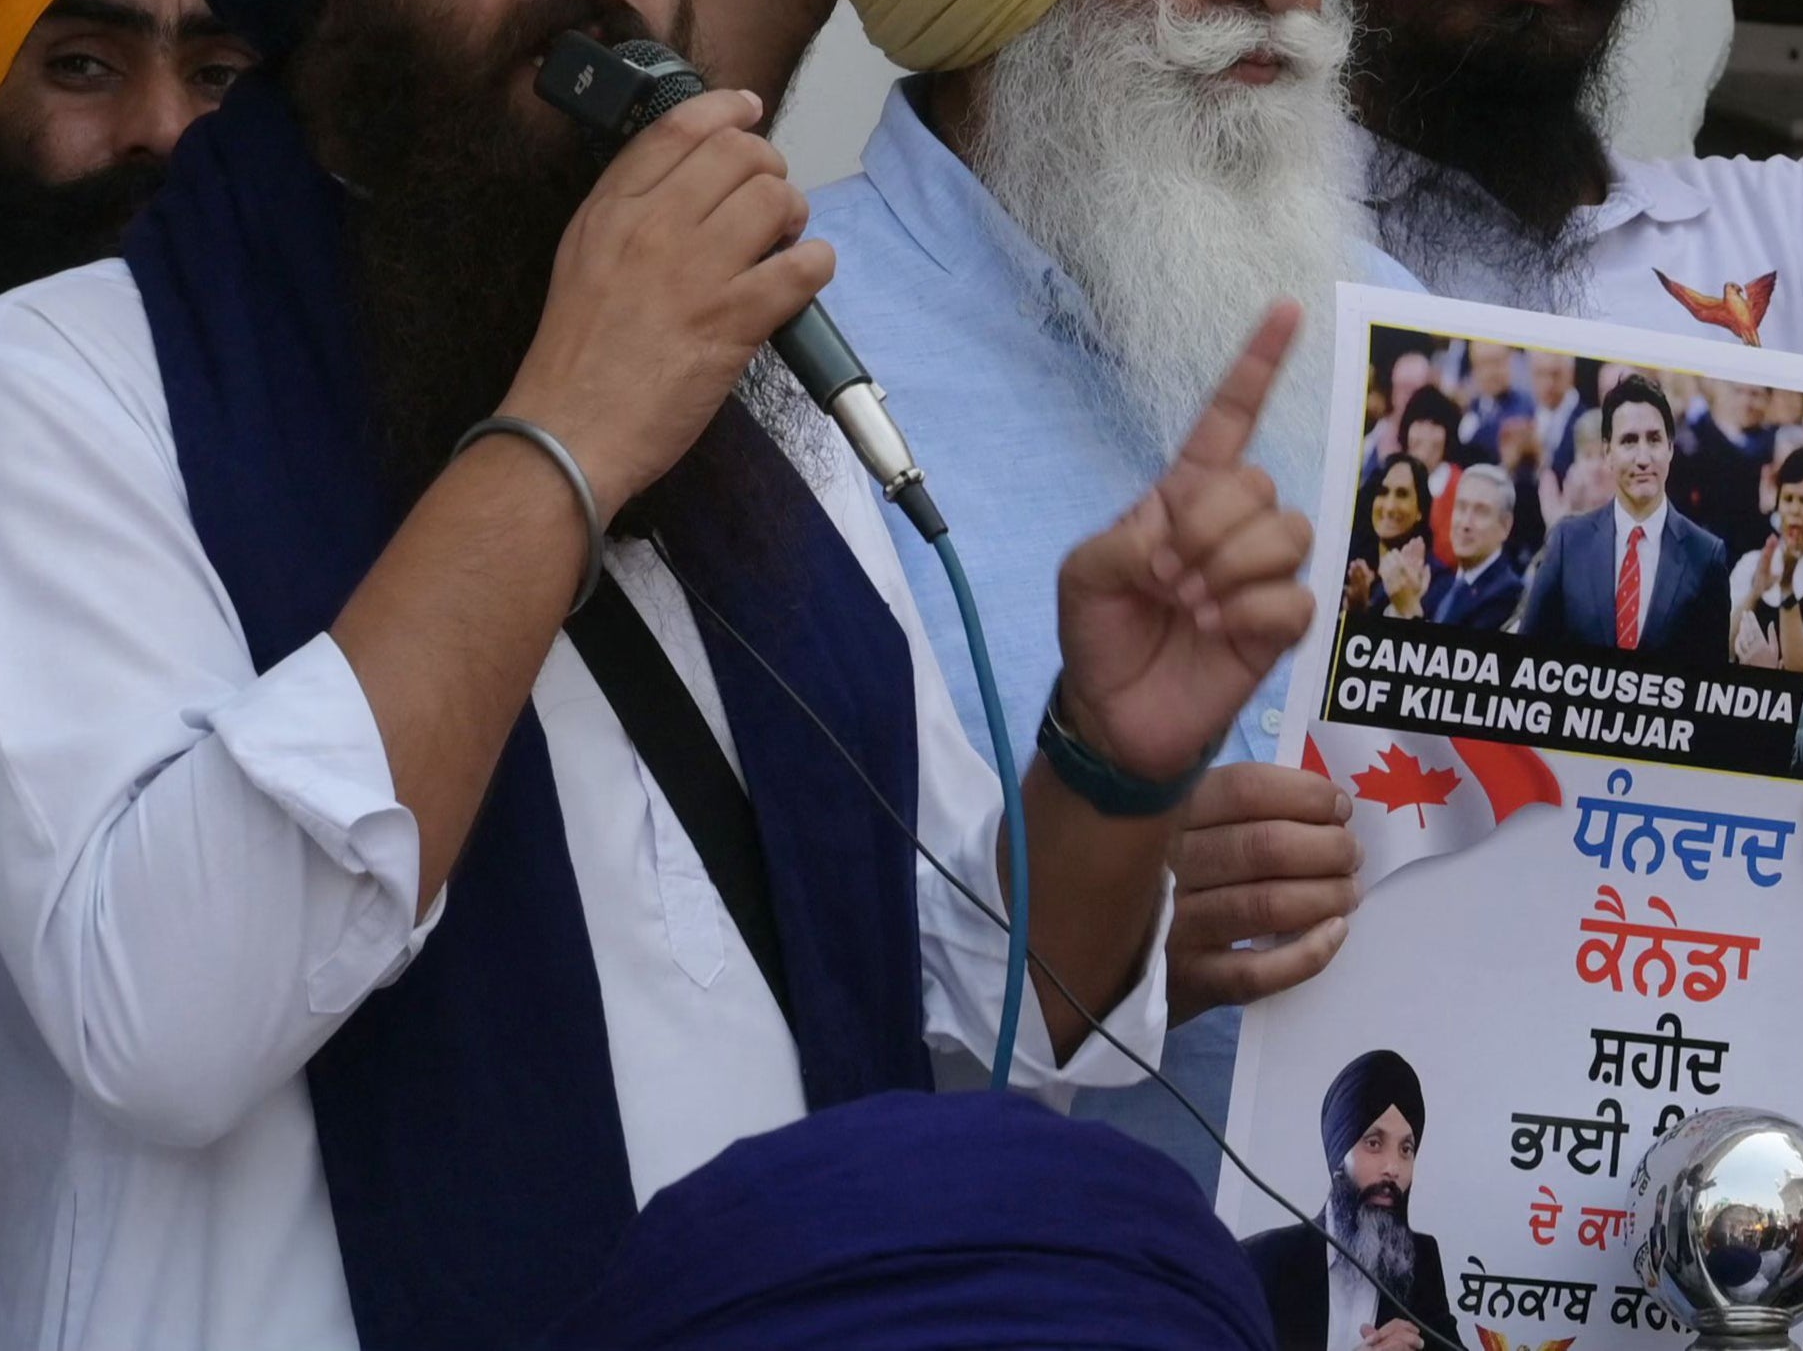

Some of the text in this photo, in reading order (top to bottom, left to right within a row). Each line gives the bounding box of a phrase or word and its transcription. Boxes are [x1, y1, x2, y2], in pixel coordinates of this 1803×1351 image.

[1338, 677, 1694, 751] OF KILLING NIJJAR
[1344, 635, 1793, 724] CANADA ACCUSES INDIA
[1574, 768, 1796, 888] ਧੰਨਵਾਦ
[1576, 884, 1760, 1003] ਕੈਨੇਡਾ
[1588, 1013, 1729, 1095] ਸ਼ਹੀਦ
[1510, 1098, 1629, 1177] ਭਾਈ
[1529, 1185, 1563, 1245] ਦੇ
[1457, 1256, 1597, 1324] ਬੇਨਕਾਬ
